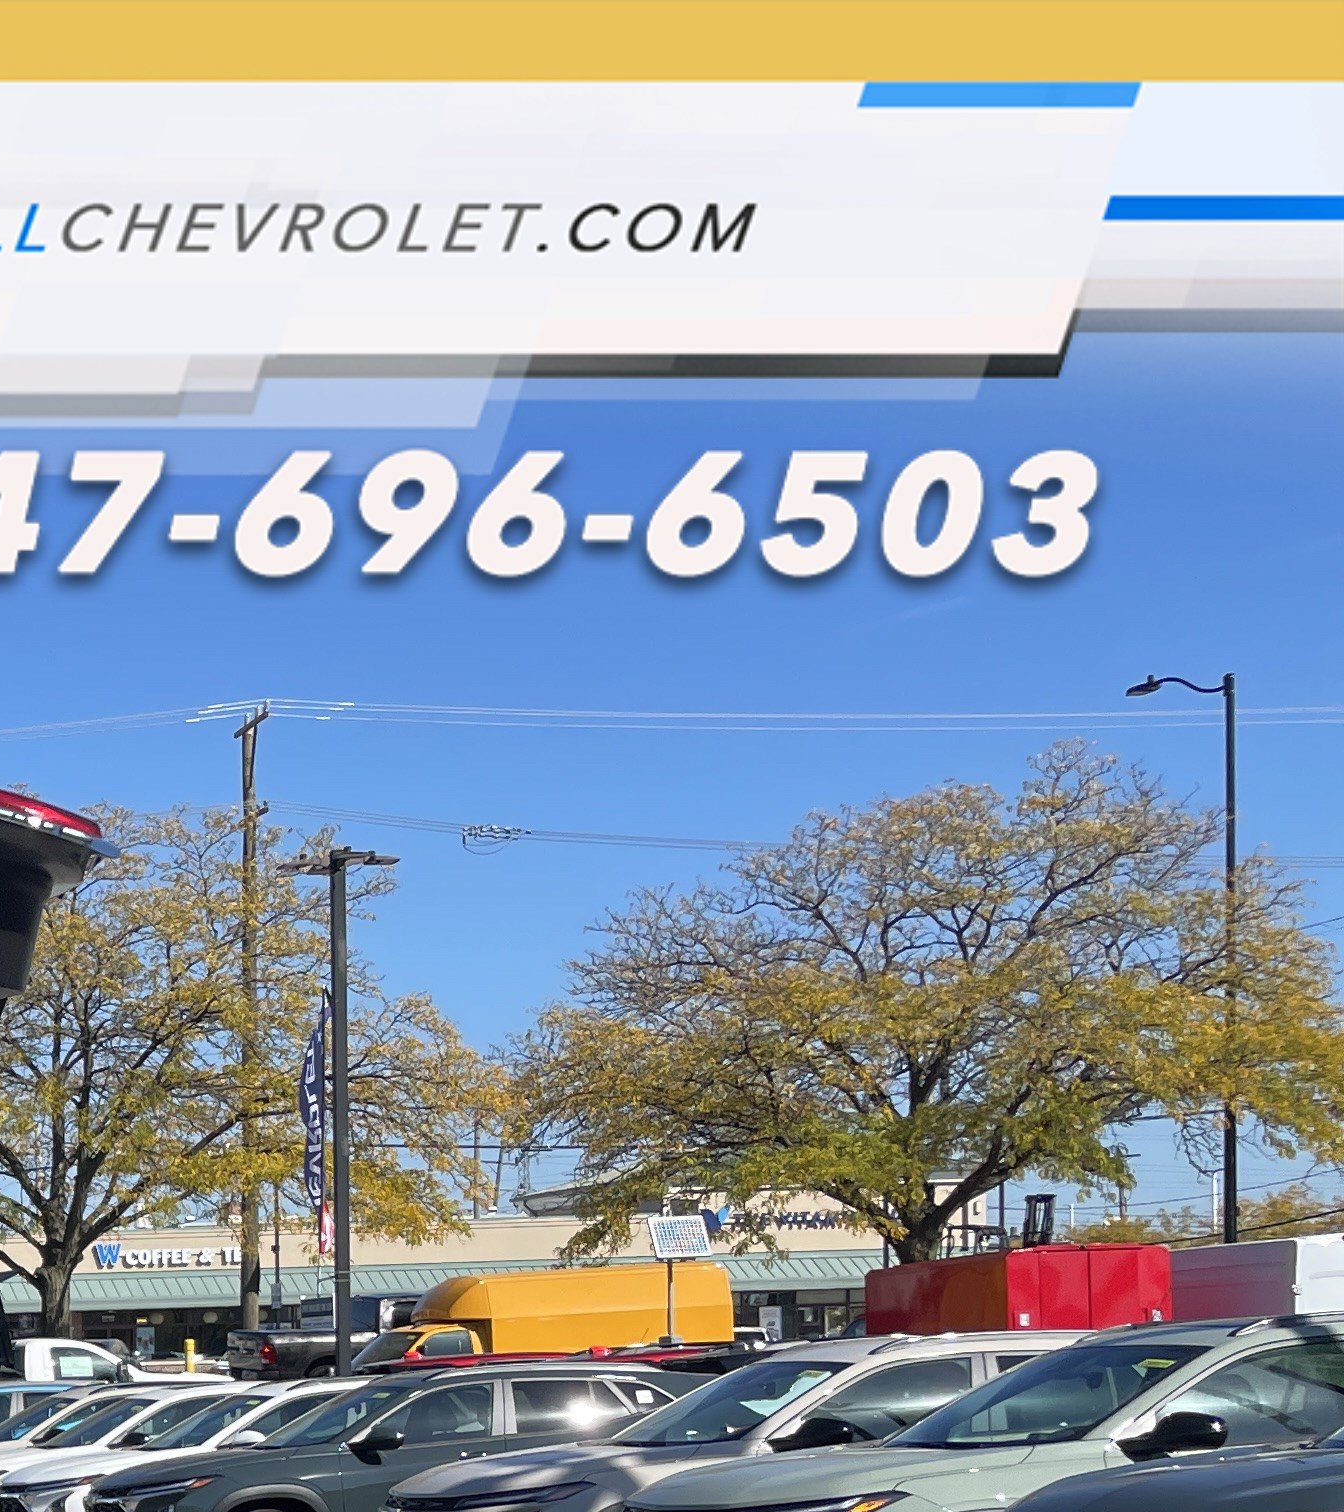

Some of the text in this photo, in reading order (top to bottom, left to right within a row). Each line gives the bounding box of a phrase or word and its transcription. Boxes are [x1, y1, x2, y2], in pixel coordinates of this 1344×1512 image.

[95, 1243, 242, 1266] W COFFEE & TE
